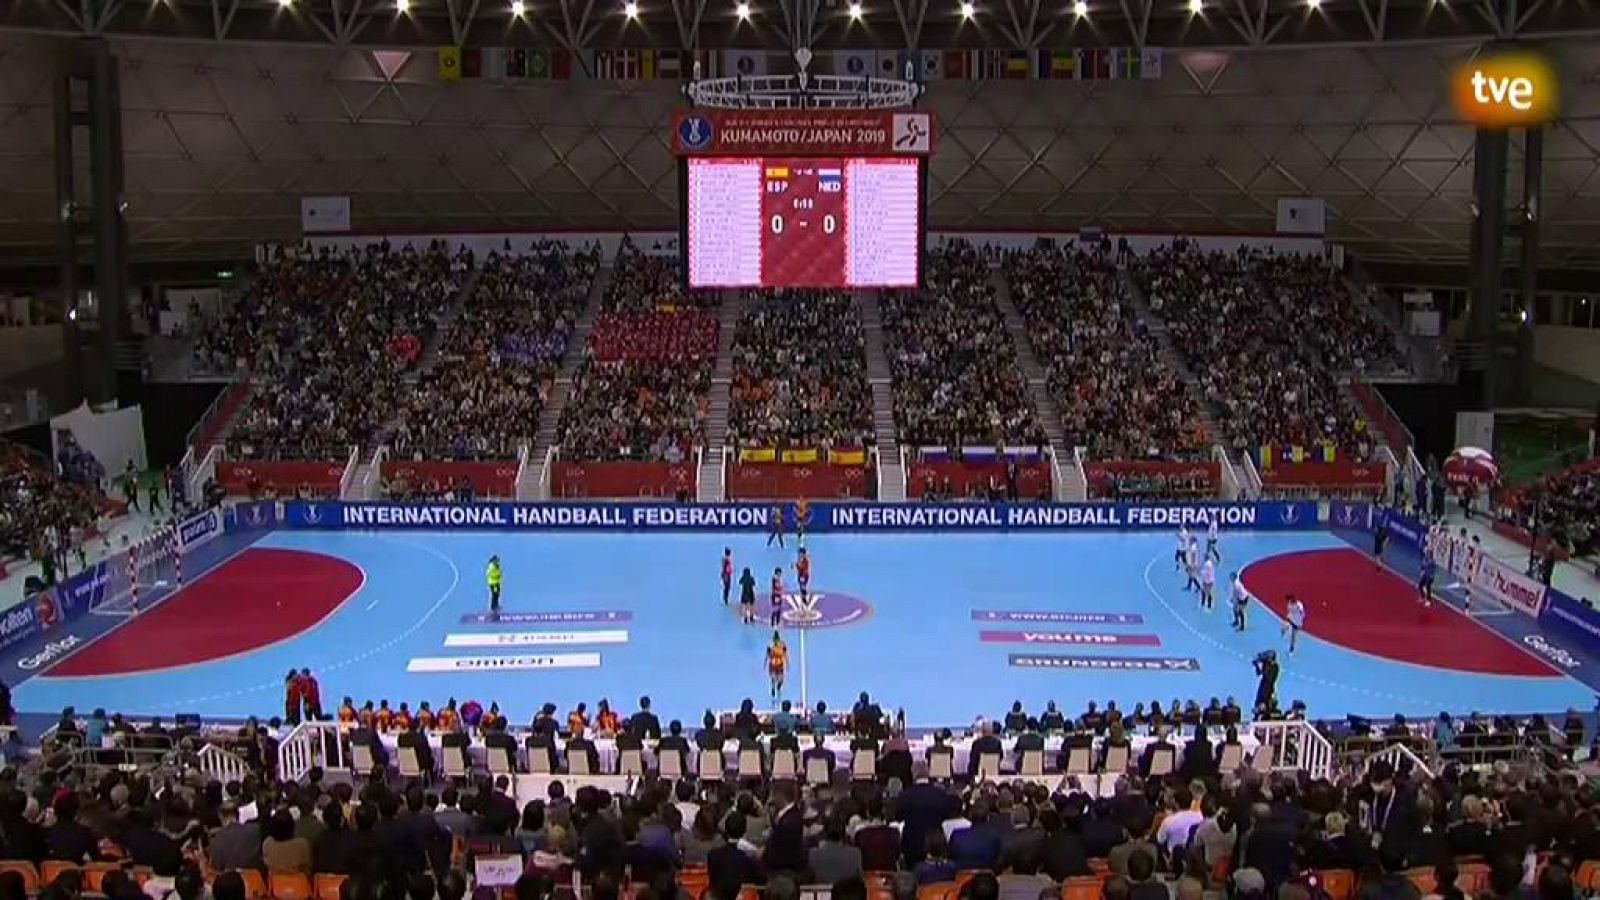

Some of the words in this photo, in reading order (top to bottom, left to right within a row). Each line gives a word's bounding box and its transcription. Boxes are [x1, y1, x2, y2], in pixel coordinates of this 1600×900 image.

[857, 128, 886, 143] 2019
[772, 214, 784, 234] 0
[824, 214, 836, 234] 0
[343, 507, 506, 524] INTERNATIONAL
[513, 507, 626, 524] HANDBALL
[633, 507, 767, 525] FEDERATION
[832, 507, 1002, 525] INTERNATIONAL
[1008, 507, 1121, 525] HANDBALL
[1127, 507, 1256, 524] FEDERATION
[1496, 569, 1541, 608] hummel
